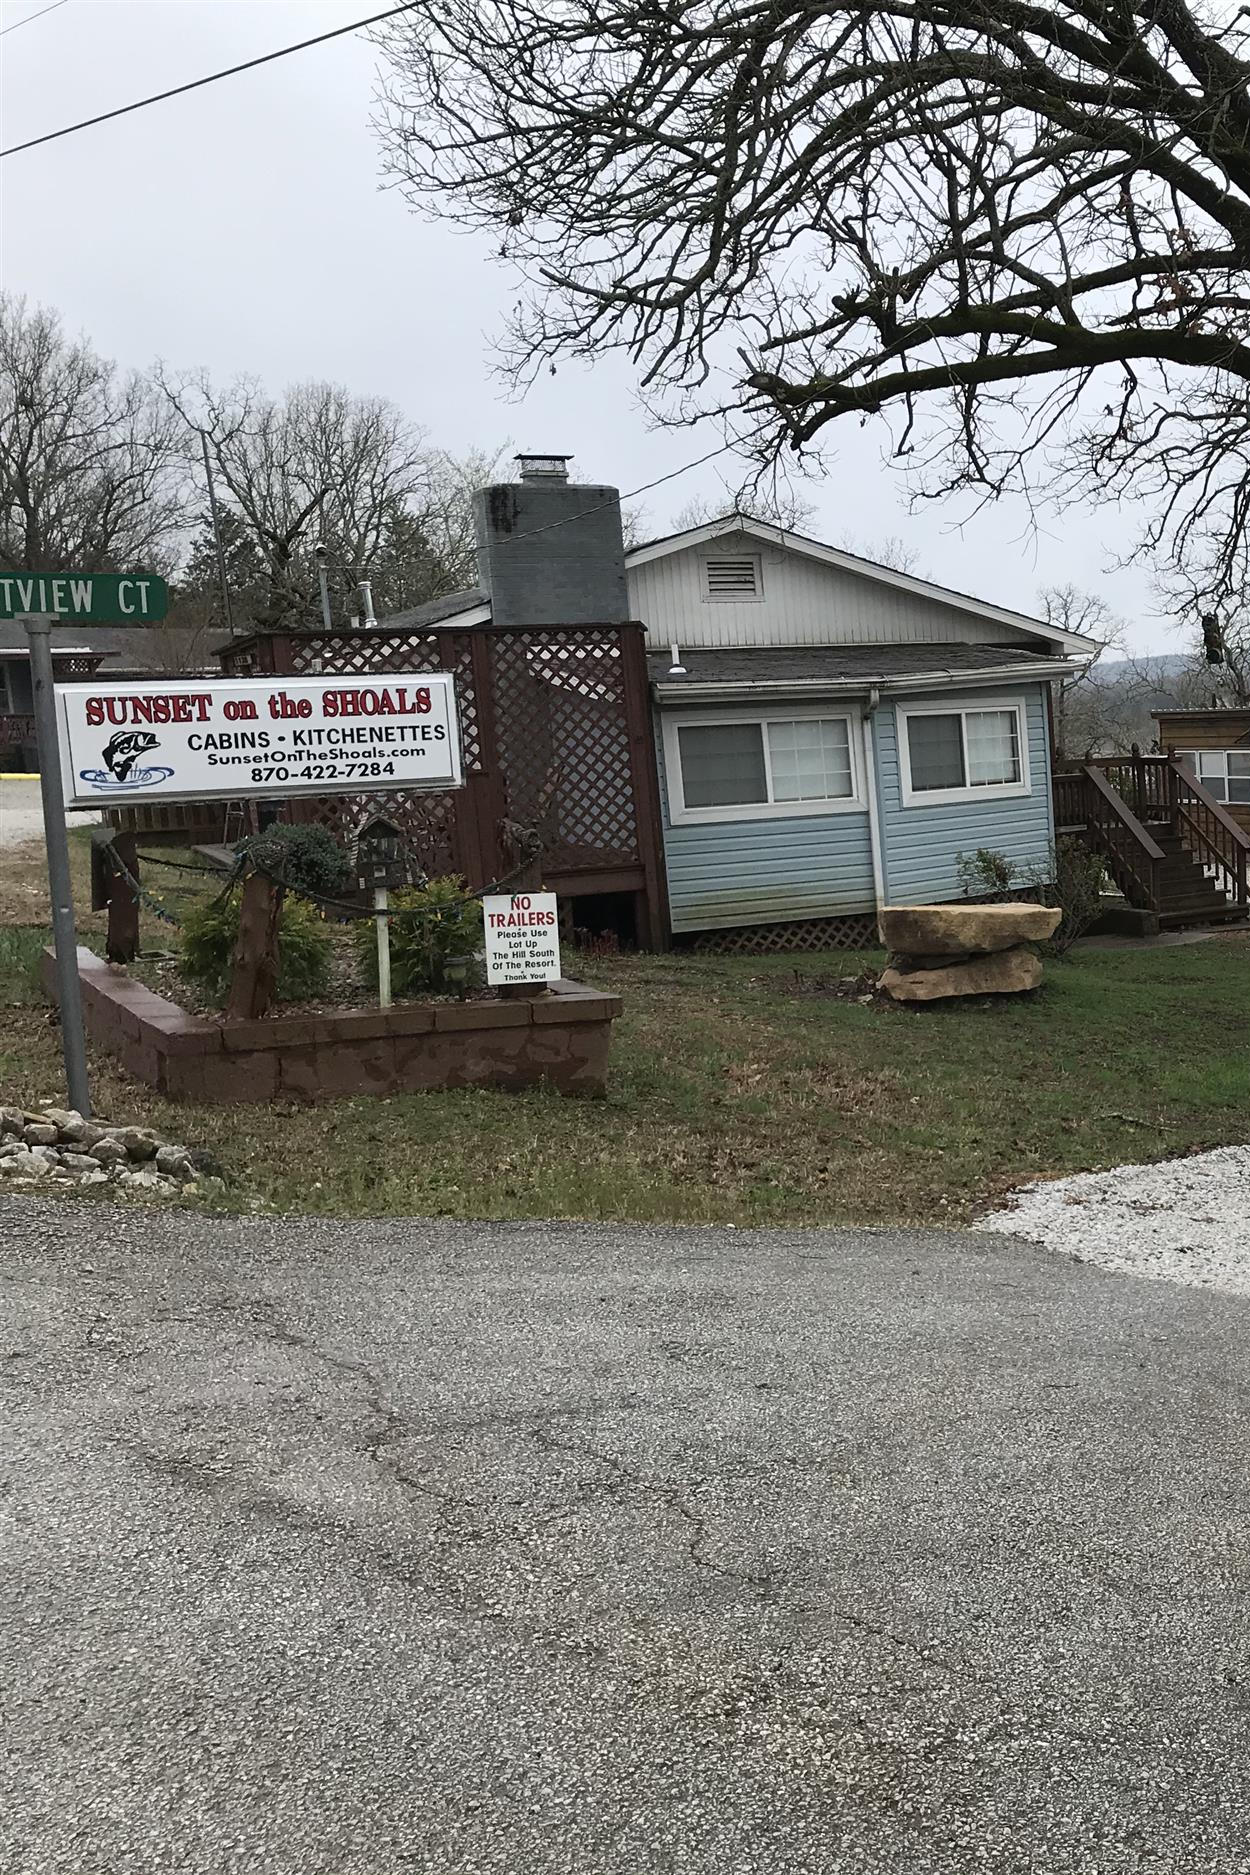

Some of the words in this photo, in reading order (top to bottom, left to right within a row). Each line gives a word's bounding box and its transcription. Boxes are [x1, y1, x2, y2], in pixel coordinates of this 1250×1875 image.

[118, 580, 150, 614] CT
[85, 694, 213, 726] SUNSET
[223, 697, 259, 720] on
[268, 692, 313, 719] the
[322, 687, 432, 718] SHOALS
[187, 731, 270, 751] CABINS
[292, 724, 446, 746] KITCHENETTES
[208, 746, 426, 766] SunsetOnTheShoals.com
[251, 761, 395, 782] 870-422-7284
[511, 896, 531, 910] NO
[488, 911, 555, 928] TRAILERS
[497, 931, 528, 939] Please
[530, 929, 548, 937] Use
[508, 941, 522, 949] Lot
[525, 940, 538, 949] Up
[493, 952, 509, 960] The
[512, 951, 526, 959] Hill
[529, 950, 555, 958] South
[492, 962, 503, 970] Of
[506, 961, 522, 969] The
